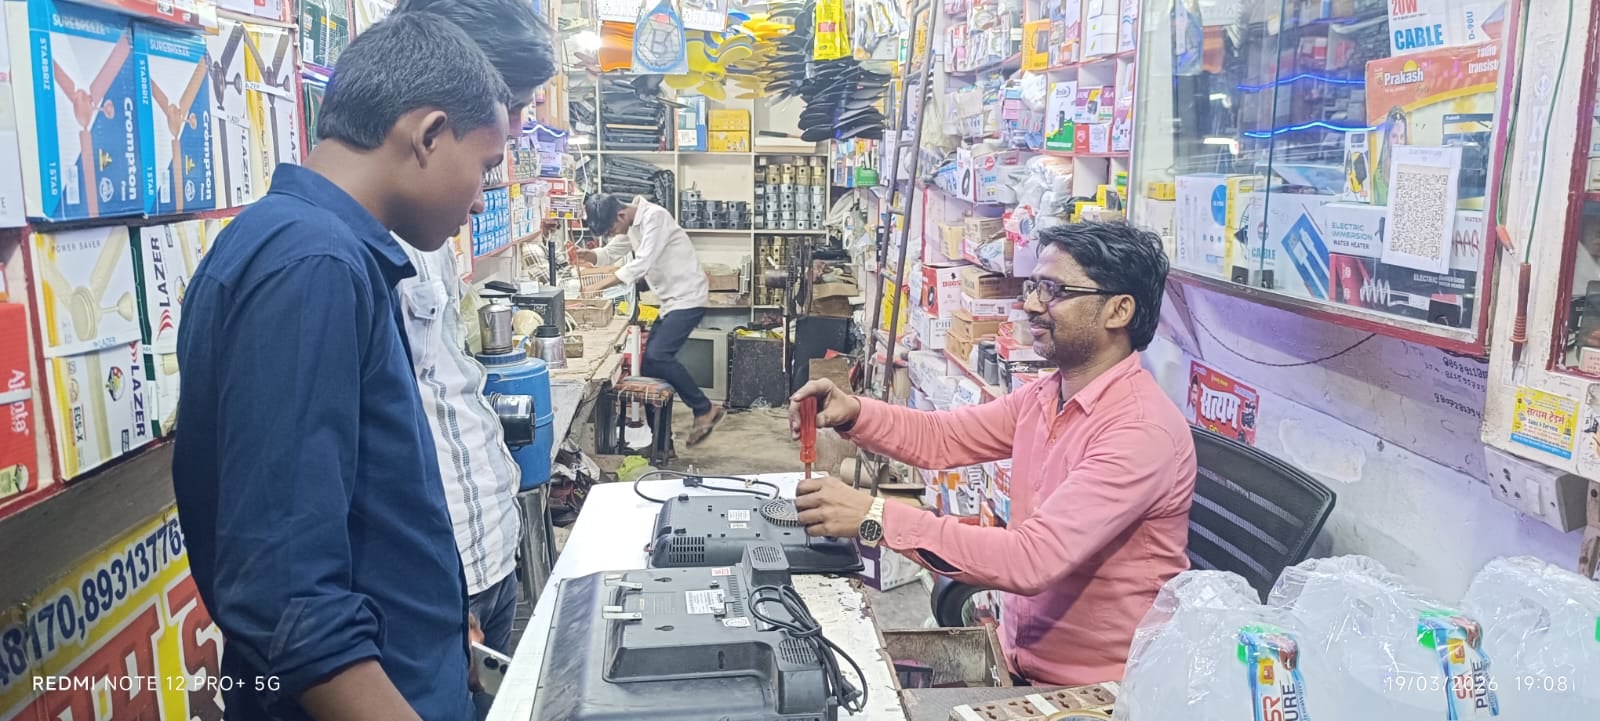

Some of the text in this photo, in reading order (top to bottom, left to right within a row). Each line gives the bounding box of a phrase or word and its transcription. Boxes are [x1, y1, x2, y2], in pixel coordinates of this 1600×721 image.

[1394, 24, 1444, 50] CABLE
[1384, 68, 1424, 86] Prakash
[124, 97, 136, 200] Crompton
[203, 110, 212, 200] Crompton
[241, 132, 250, 195] LAZER
[288, 131, 297, 165] LAZ
[79, 240, 101, 249] SAVER
[1331, 221, 1365, 232] ELECTRIC
[1331, 231, 1373, 241] IMMERSION
[1350, 241, 1370, 250] HEATER
[151, 237, 171, 308] LAZER
[7, 368, 28, 434] Ajnta
[130, 364, 146, 437] LAZER
[74, 406, 83, 442] ECS-X
[0, 519, 188, 686] 8170,89313776
[1282, 683, 1299, 721] URE
[1472, 660, 1489, 709] PURE
